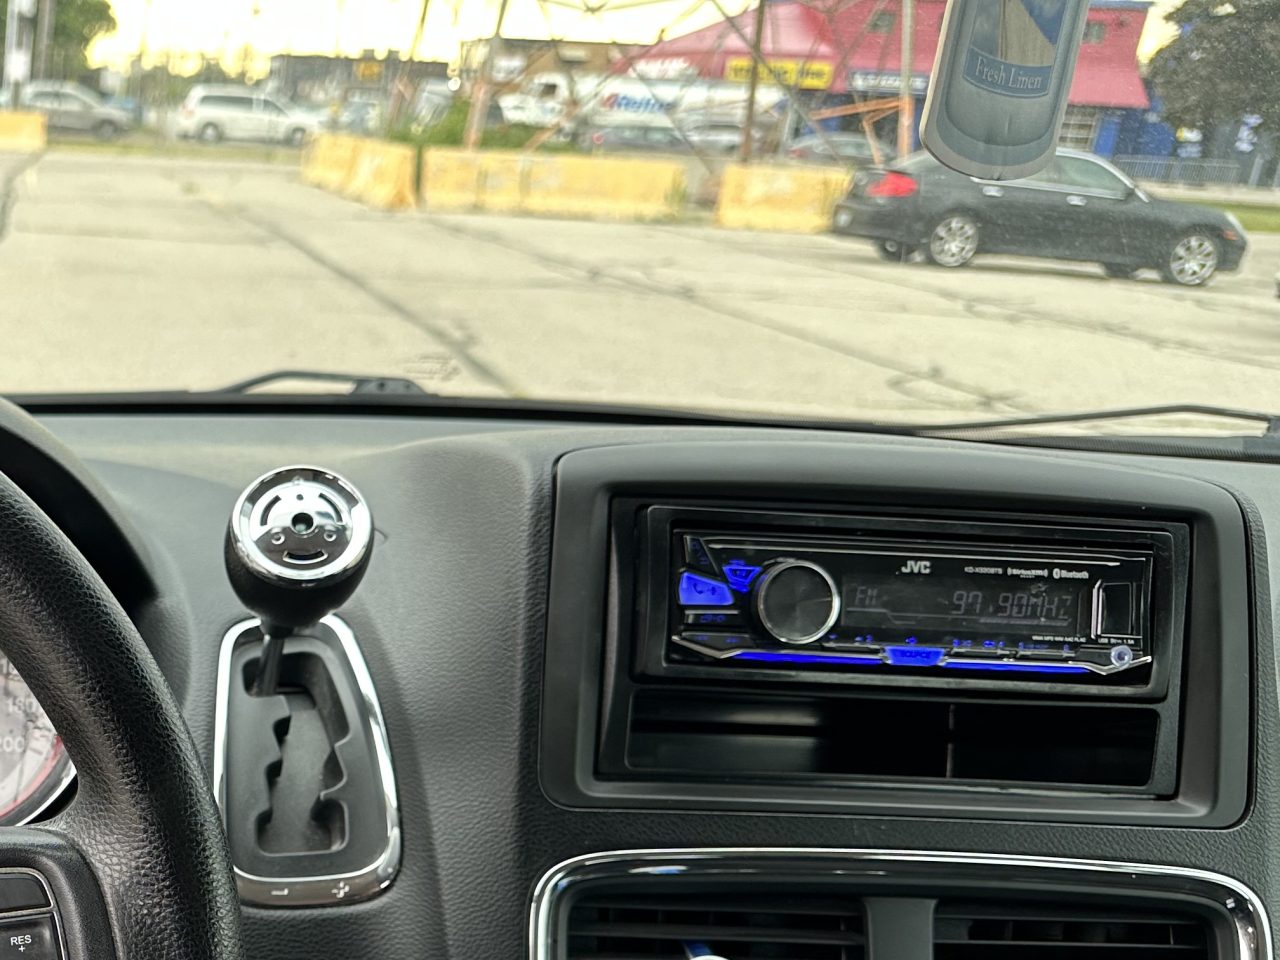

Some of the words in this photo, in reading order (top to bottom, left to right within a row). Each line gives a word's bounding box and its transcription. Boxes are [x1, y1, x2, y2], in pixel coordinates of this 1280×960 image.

[975, 56, 1006, 84] Fresh
[1008, 67, 1043, 89] Linen
[901, 560, 931, 574] JVC
[10, 935, 32, 946] RES
